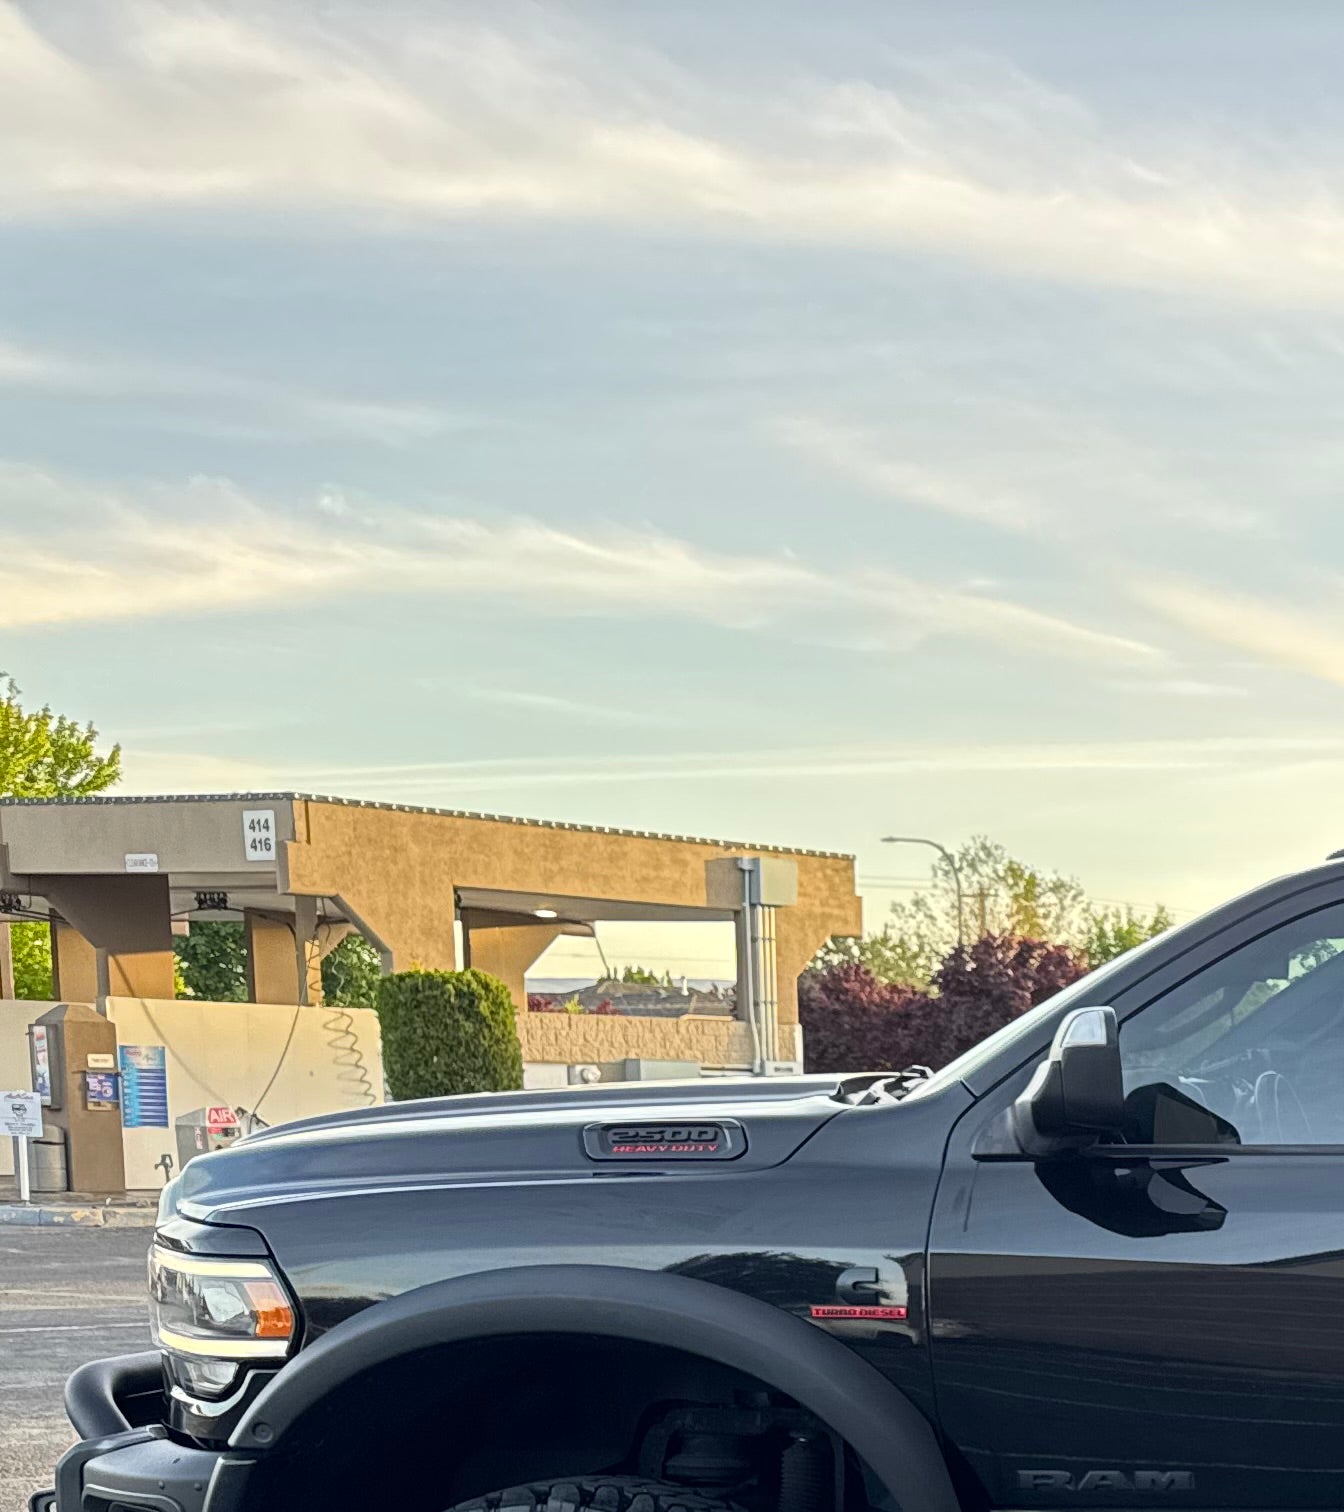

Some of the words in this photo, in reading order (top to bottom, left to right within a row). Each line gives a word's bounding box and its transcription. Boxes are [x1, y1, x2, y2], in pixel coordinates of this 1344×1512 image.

[248, 818, 270, 833] 414
[250, 837, 272, 852] 416
[209, 1108, 236, 1124] AIR
[609, 1127, 719, 1144] 2500
[612, 1144, 669, 1153] HEAVY
[671, 1144, 718, 1153] DUTY
[814, 1308, 857, 1316] TURBO
[859, 1308, 905, 1317] DIESEL
[1017, 1470, 1196, 1491] RAM
